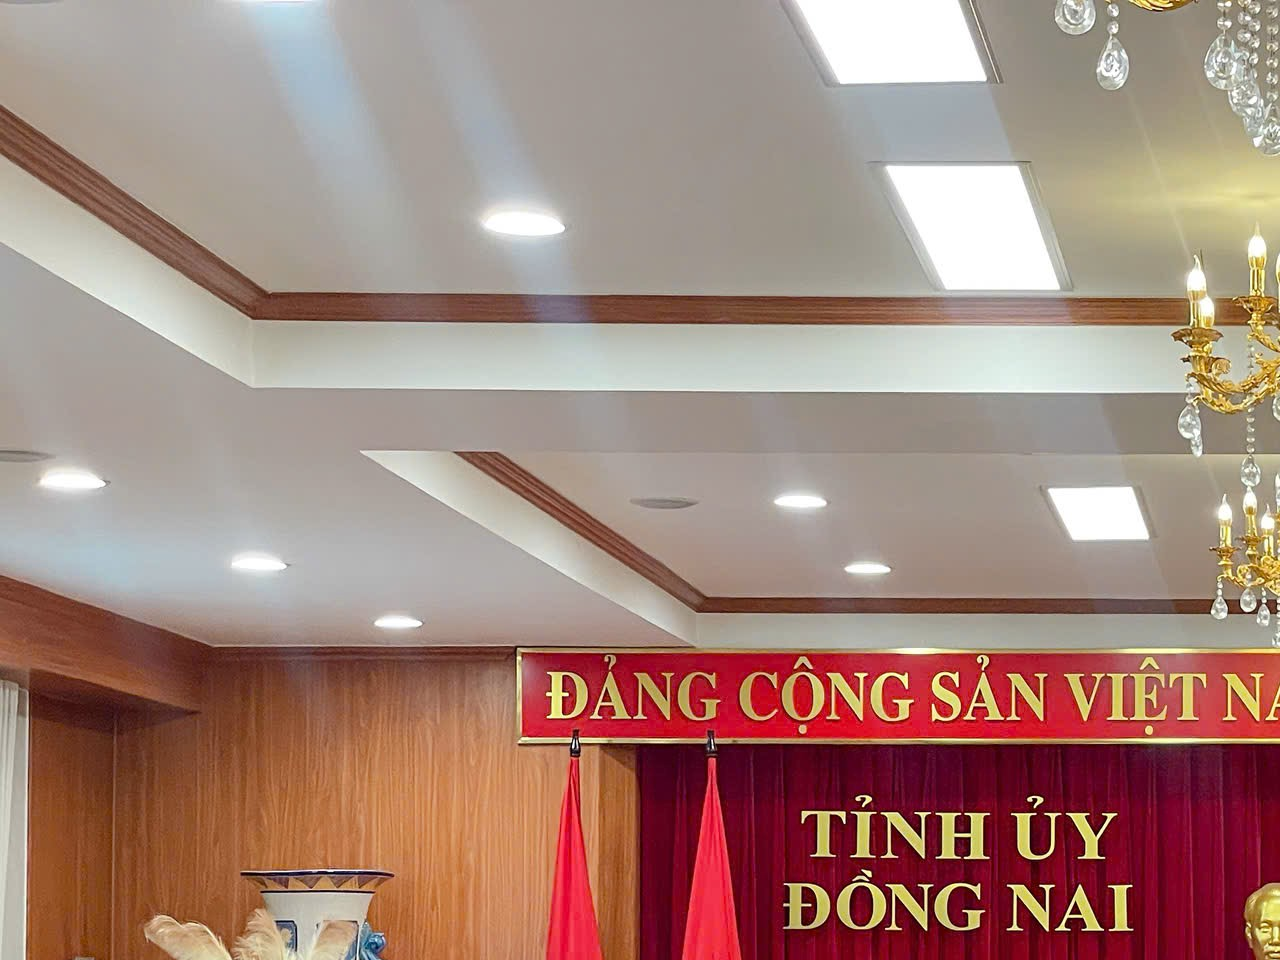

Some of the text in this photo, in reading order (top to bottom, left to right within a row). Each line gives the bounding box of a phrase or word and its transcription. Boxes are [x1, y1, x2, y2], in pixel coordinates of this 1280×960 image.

[546, 655, 720, 721] ĐẢNG
[739, 657, 914, 735] CỘNG
[932, 655, 1045, 722] SẢN
[1072, 656, 1206, 735] VIỆT
[801, 795, 1118, 860] TỈNH ỦY
[783, 870, 1134, 932] ĐỒNG NAI
